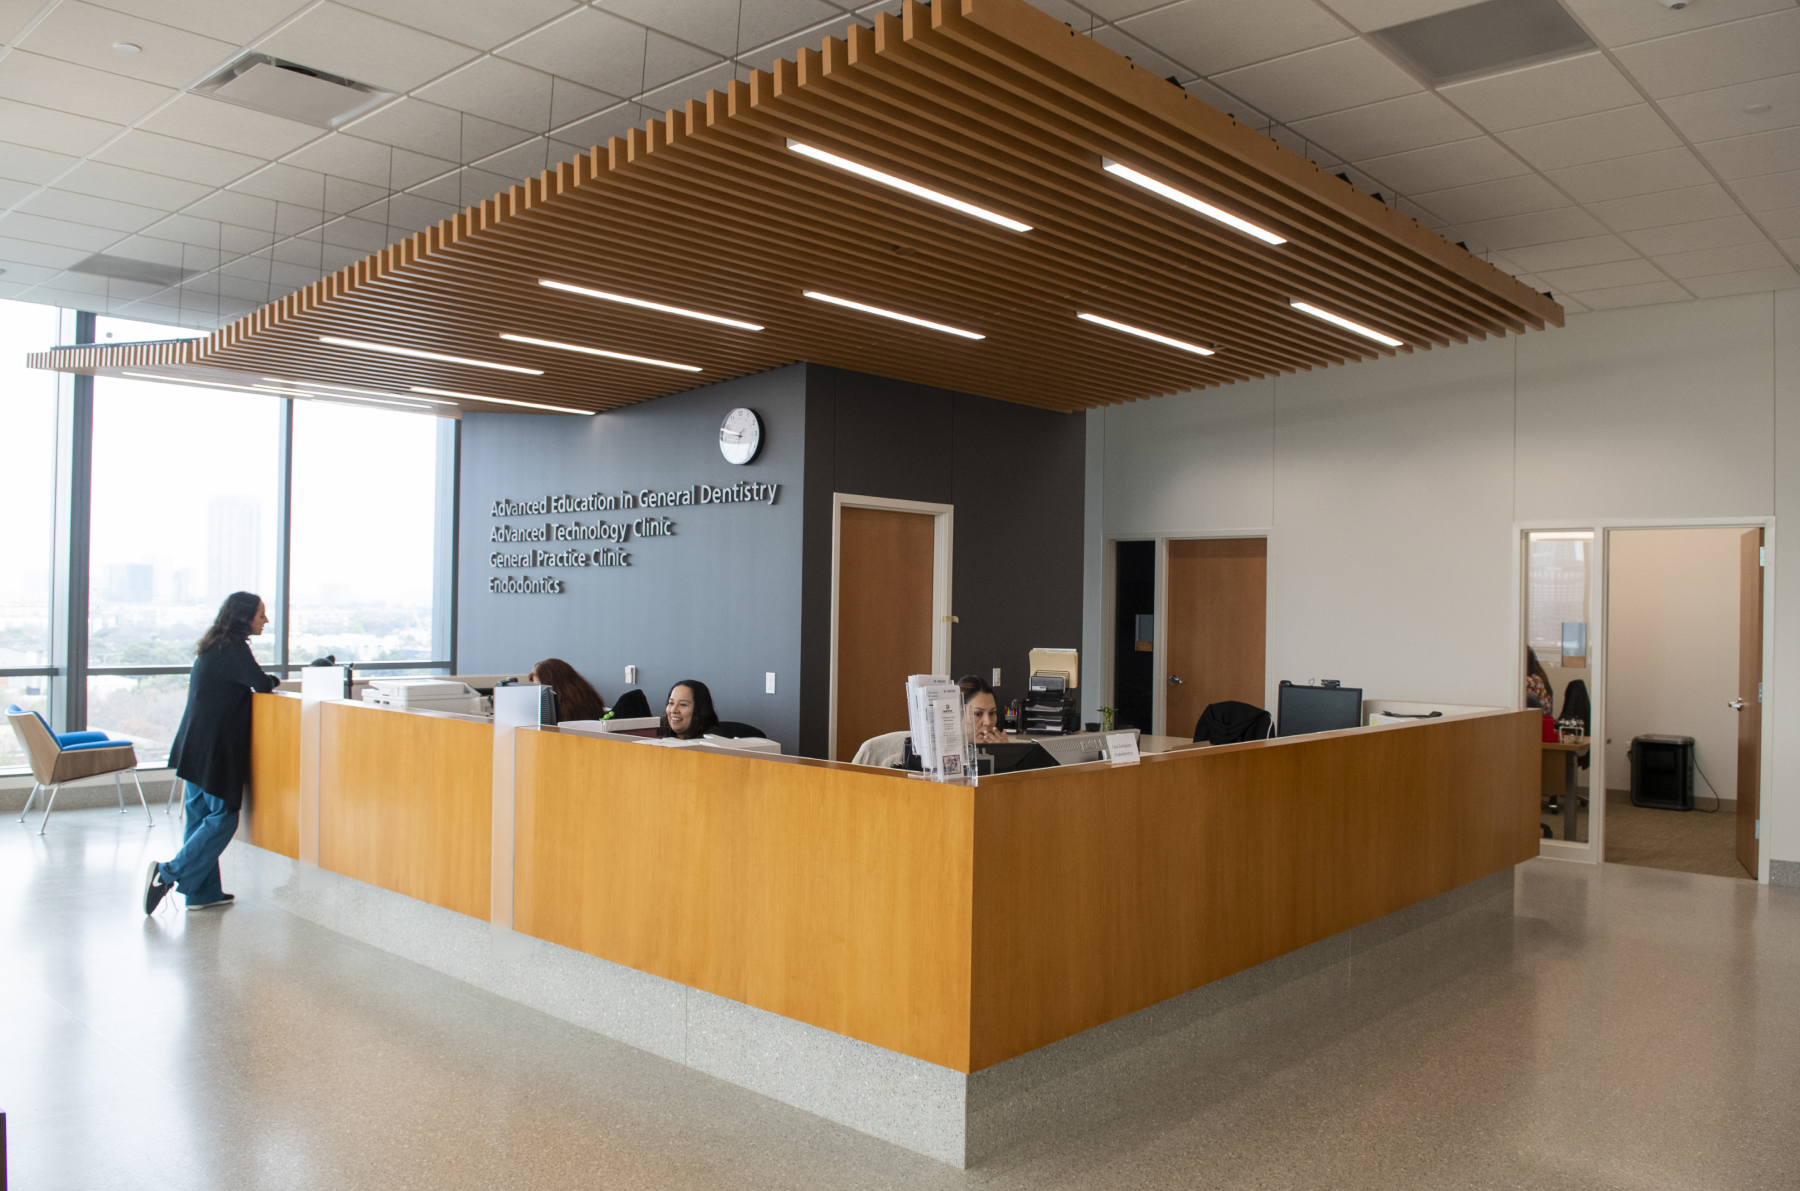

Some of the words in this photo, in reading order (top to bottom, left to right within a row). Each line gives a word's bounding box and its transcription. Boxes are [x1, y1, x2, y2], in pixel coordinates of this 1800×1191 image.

[490, 495, 548, 517] Advanced
[551, 492, 616, 513] Education
[620, 490, 633, 509] in
[639, 485, 696, 508] General
[700, 480, 778, 505] Dentistry
[489, 523, 547, 542] Advanced
[551, 519, 628, 543] Technology
[633, 516, 672, 537] Clinic
[489, 549, 534, 567] General
[537, 548, 587, 567] Practice
[591, 547, 628, 566] Clinic
[488, 575, 561, 593] Endodontics
